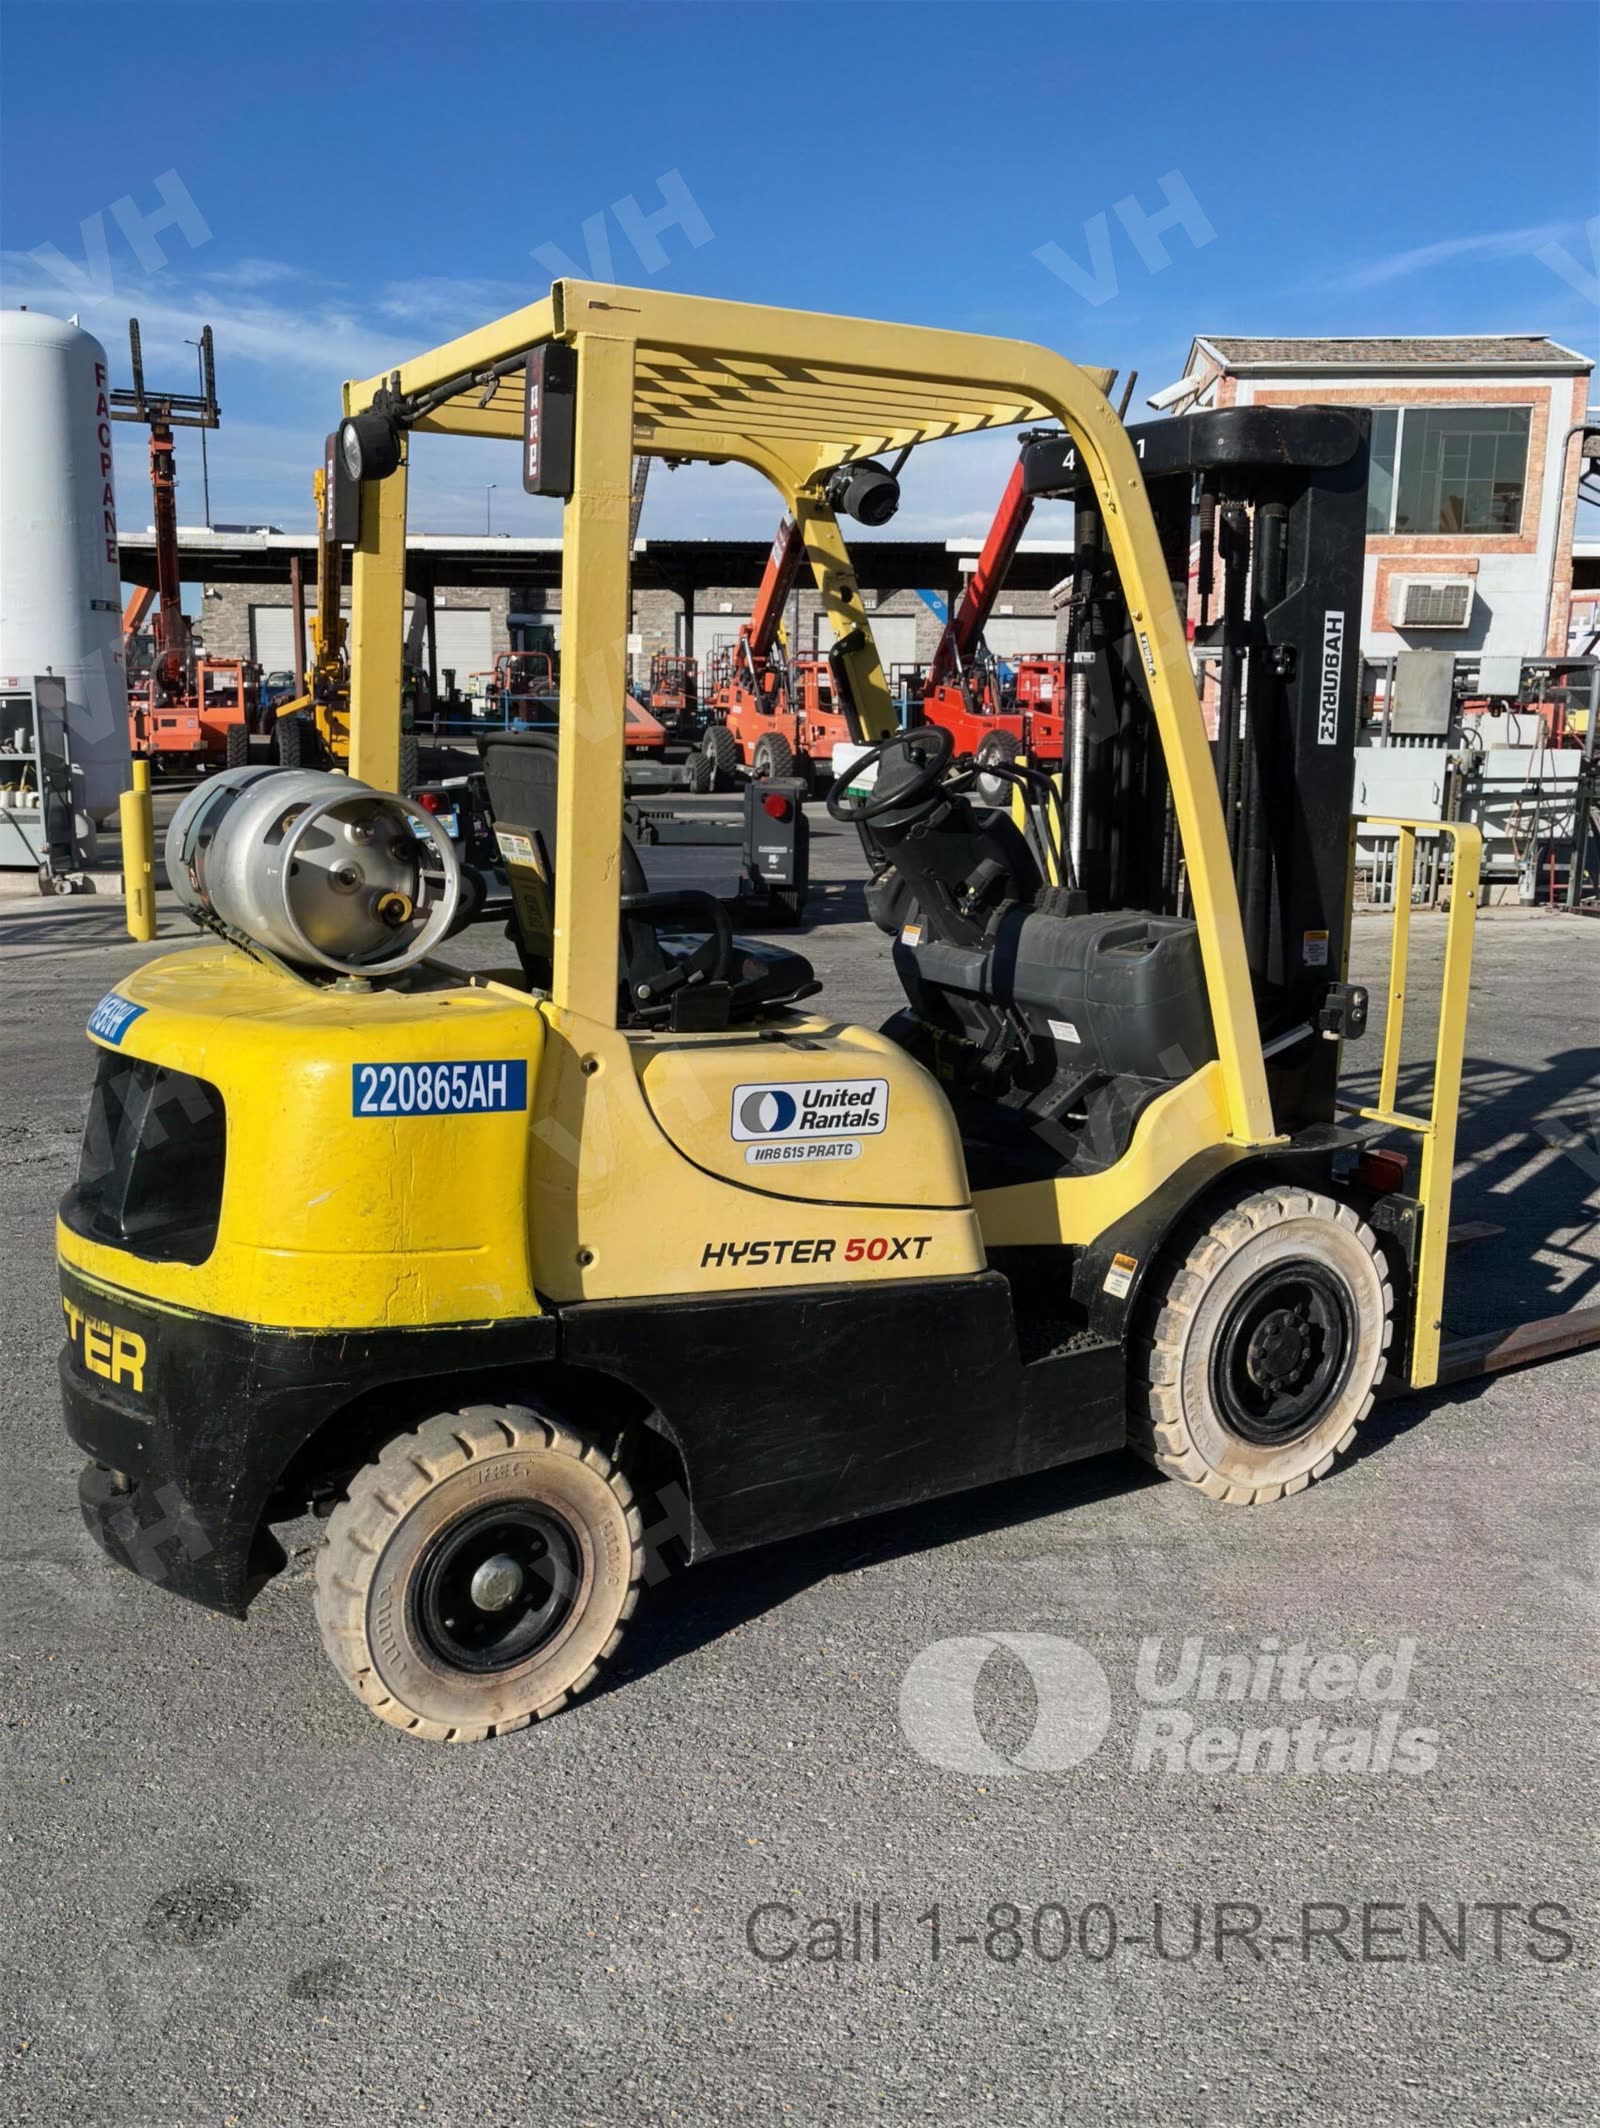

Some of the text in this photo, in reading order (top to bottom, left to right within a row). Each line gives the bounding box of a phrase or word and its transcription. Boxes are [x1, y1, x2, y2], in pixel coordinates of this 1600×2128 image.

[359, 1063, 507, 1113] 220865AH
[801, 1086, 877, 1109] United
[700, 1239, 837, 1268] HYSTER
